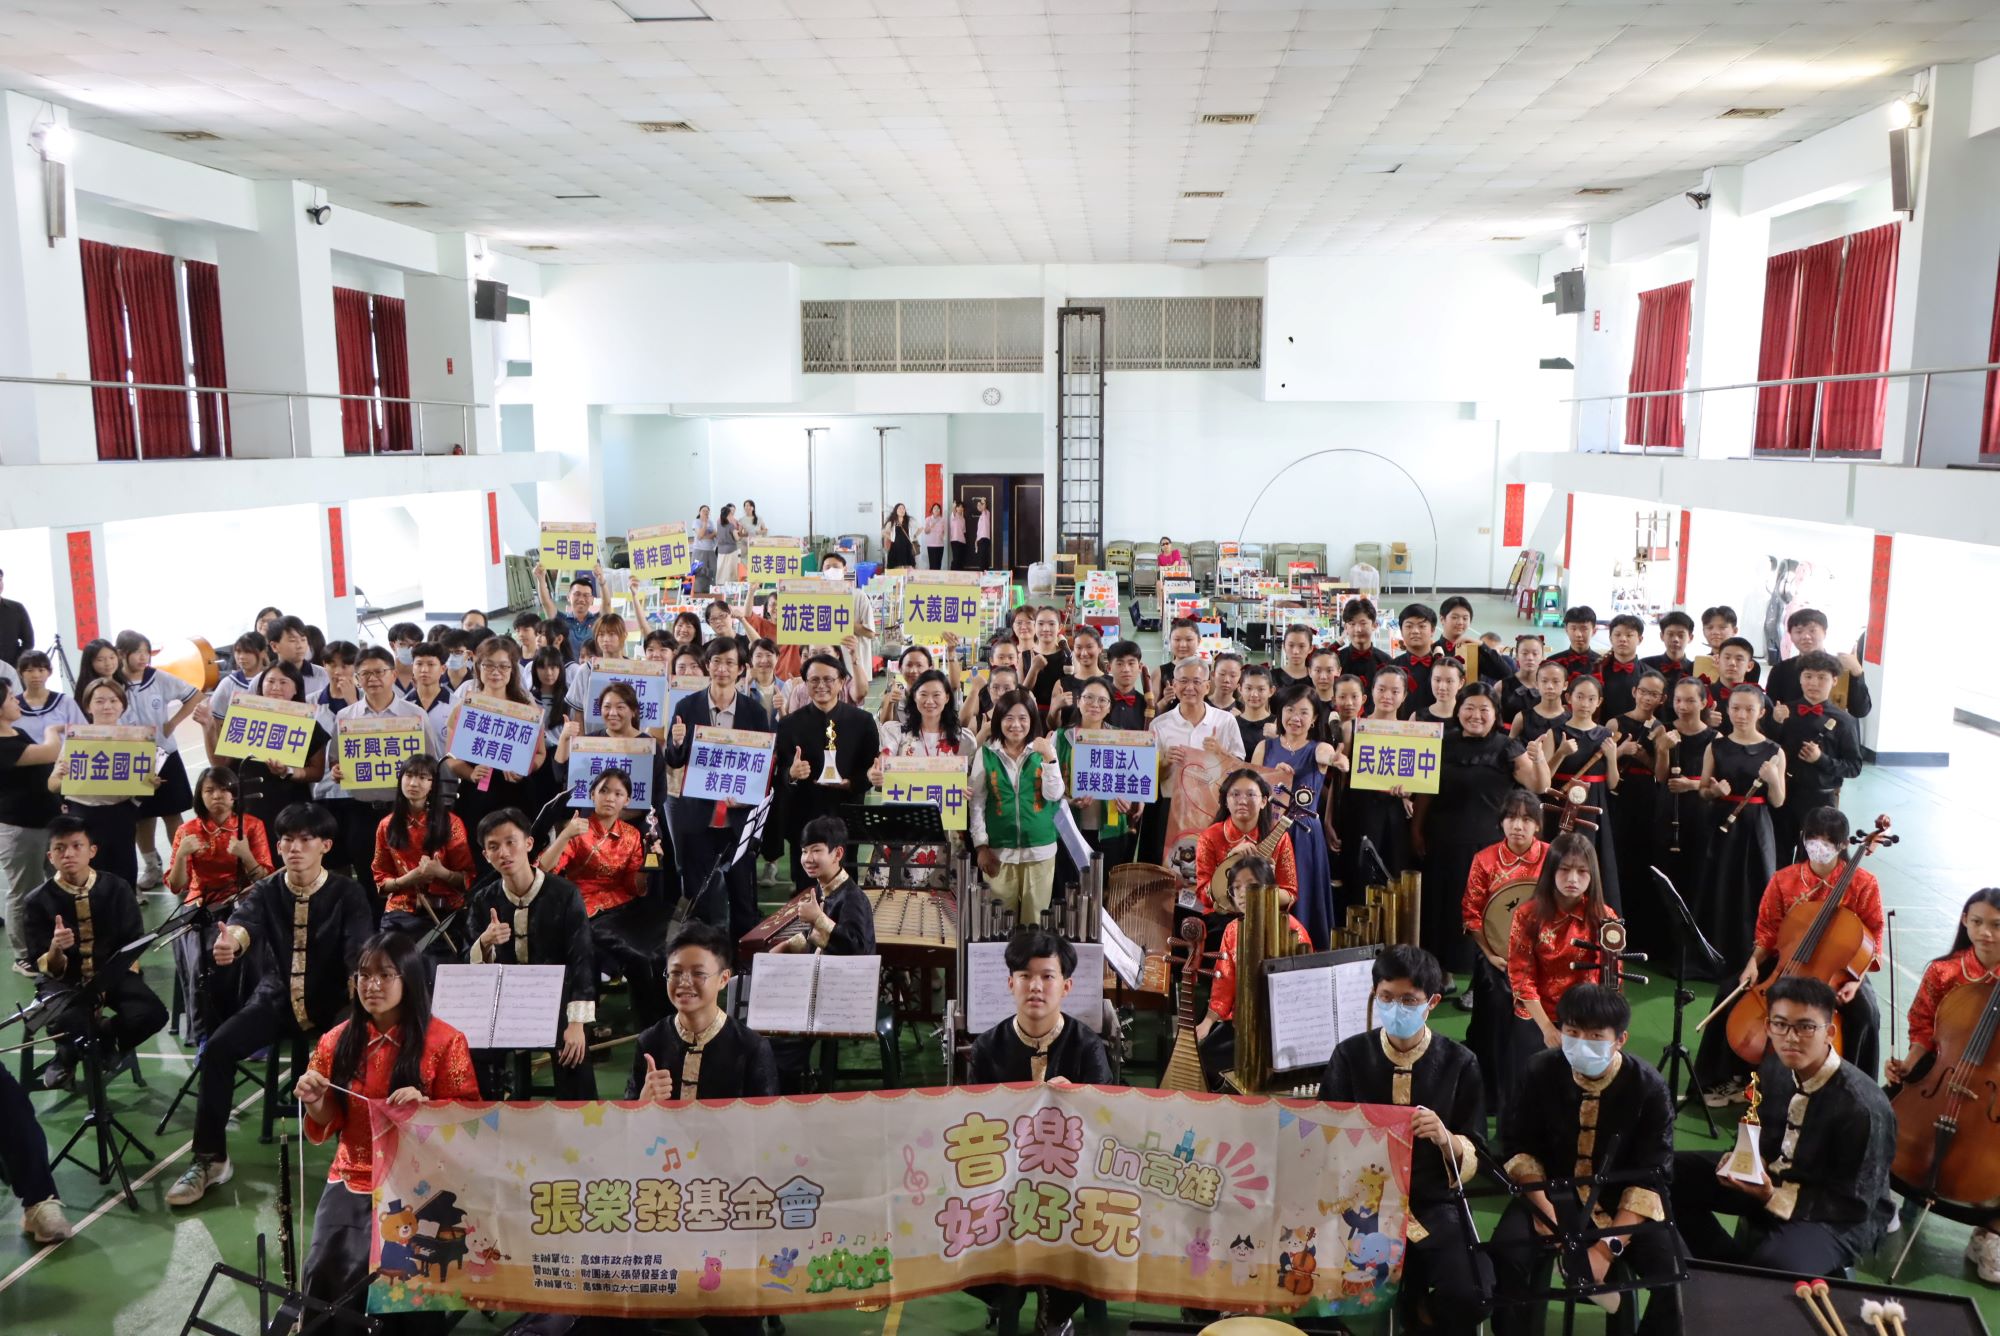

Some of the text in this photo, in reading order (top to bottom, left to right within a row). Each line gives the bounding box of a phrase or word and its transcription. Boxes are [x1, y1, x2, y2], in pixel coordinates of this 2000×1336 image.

[543, 540, 594, 560] 一甲國中
[633, 541, 686, 570] 楠梓國中
[751, 555, 798, 574] 忠孝國中
[782, 604, 849, 632] 茄萣國中
[909, 594, 976, 624] 大義國中
[225, 717, 307, 753] 陽明國中
[463, 711, 533, 745] 高雄市政府
[344, 735, 420, 759] 新興高中
[471, 737, 513, 764] 教育局
[695, 746, 766, 773] 高雄市政府
[1090, 749, 1139, 770] 財團法人
[69, 750, 151, 781] 前金國中
[1357, 745, 1436, 779] 民族國中
[705, 771, 747, 795] 教育局
[1077, 772, 1151, 795] 張榮發基金會
[944, 1107, 1084, 1188] 音樂
[530, 1175, 824, 1235] 張榮發基金會
[935, 1178, 1142, 1257] 好好玩
